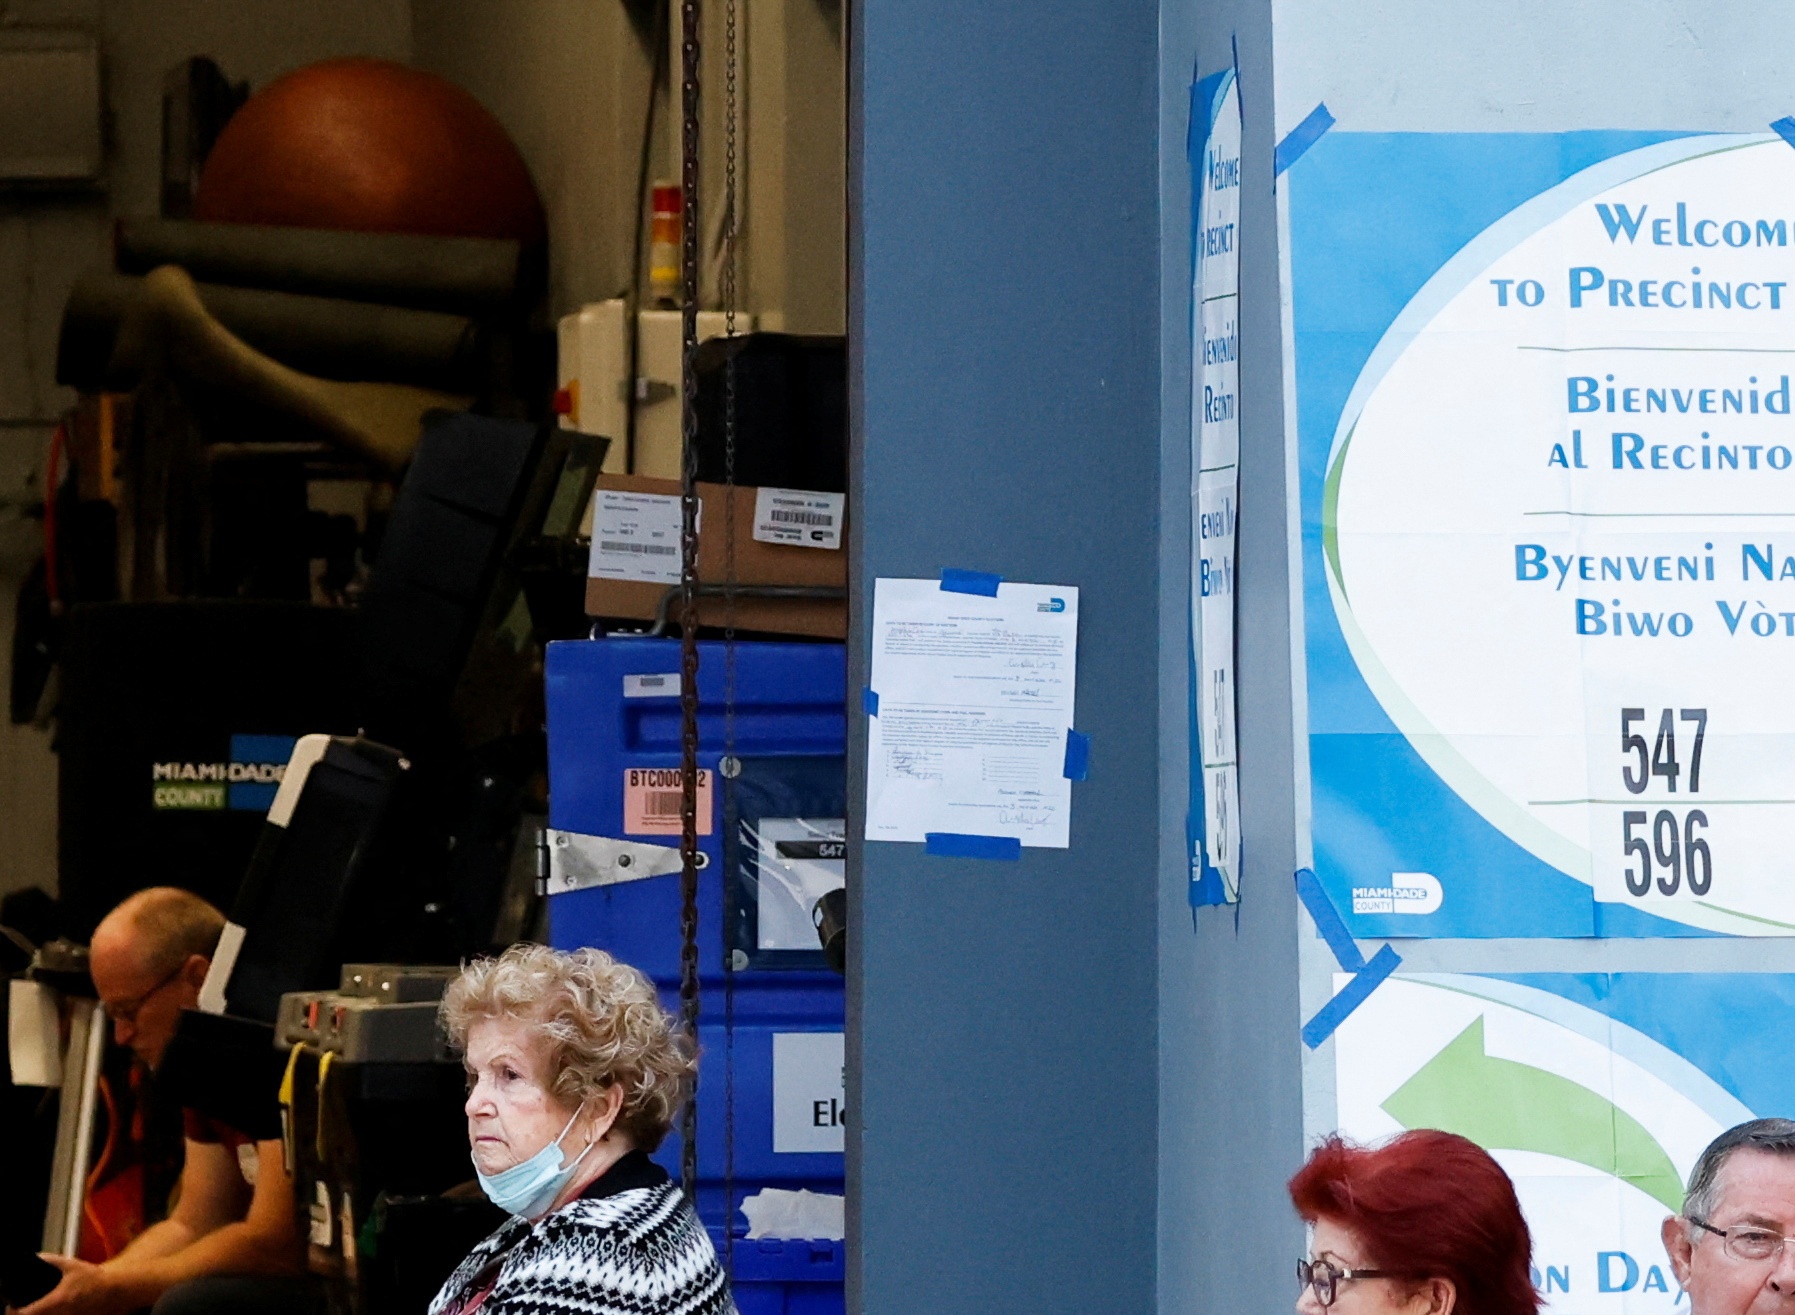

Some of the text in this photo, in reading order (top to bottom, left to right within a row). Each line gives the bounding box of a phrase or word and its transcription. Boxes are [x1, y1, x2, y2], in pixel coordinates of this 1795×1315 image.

[1489, 278, 1546, 308] to
[1568, 265, 1788, 311] Precinct
[1547, 428, 1589, 470] al
[1611, 431, 1793, 471] Recinto
[1514, 541, 1715, 589] Byenveni
[1574, 597, 1695, 638] Biwo
[1620, 707, 1708, 795] 547
[154, 787, 223, 807] COUNTY
[630, 770, 706, 788] BTC0002
[1622, 803, 1713, 897] 596
[1352, 887, 1427, 899] MIAMI-DADE
[1354, 901, 1392, 911] COUNTY
